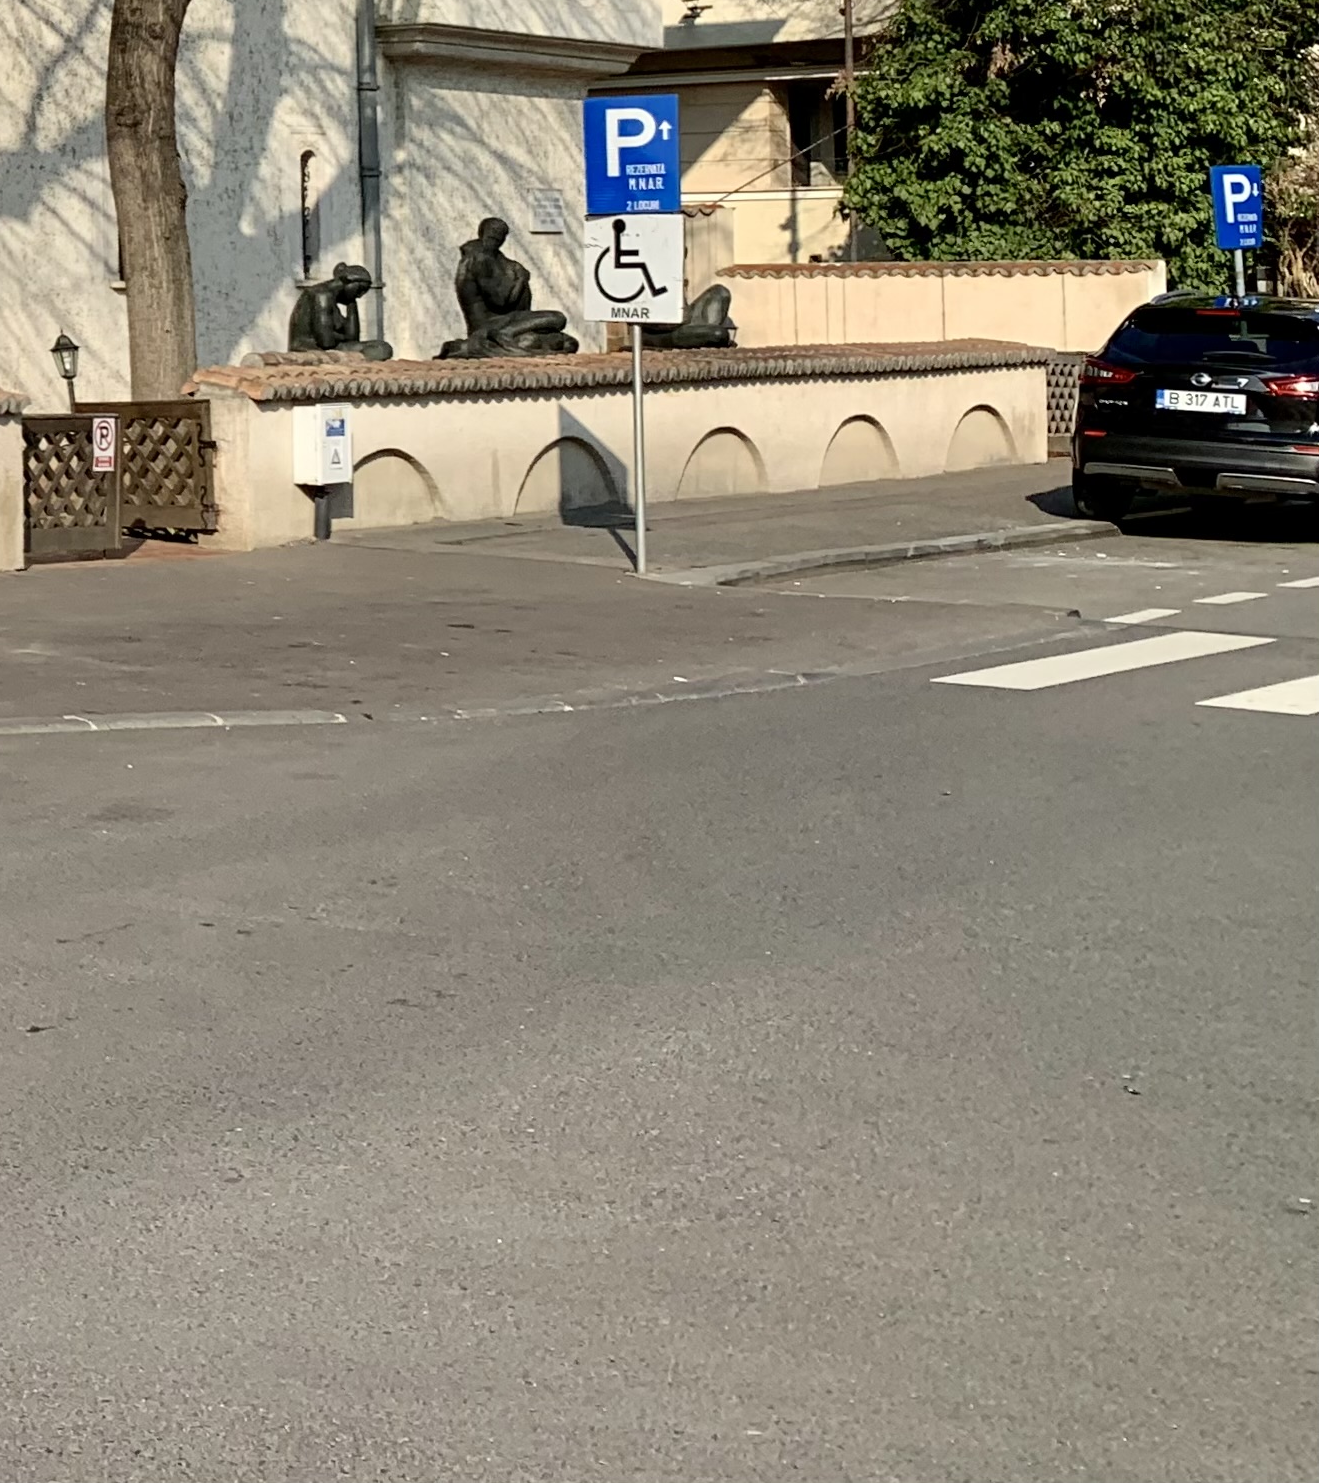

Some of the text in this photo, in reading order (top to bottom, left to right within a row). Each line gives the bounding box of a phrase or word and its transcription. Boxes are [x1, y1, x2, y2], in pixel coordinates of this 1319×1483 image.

[605, 108, 657, 177] P
[626, 201, 632, 211] 2
[1222, 174, 1251, 223] P
[611, 307, 650, 318] MNAR
[1169, 392, 1239, 409] B 317 ATL
